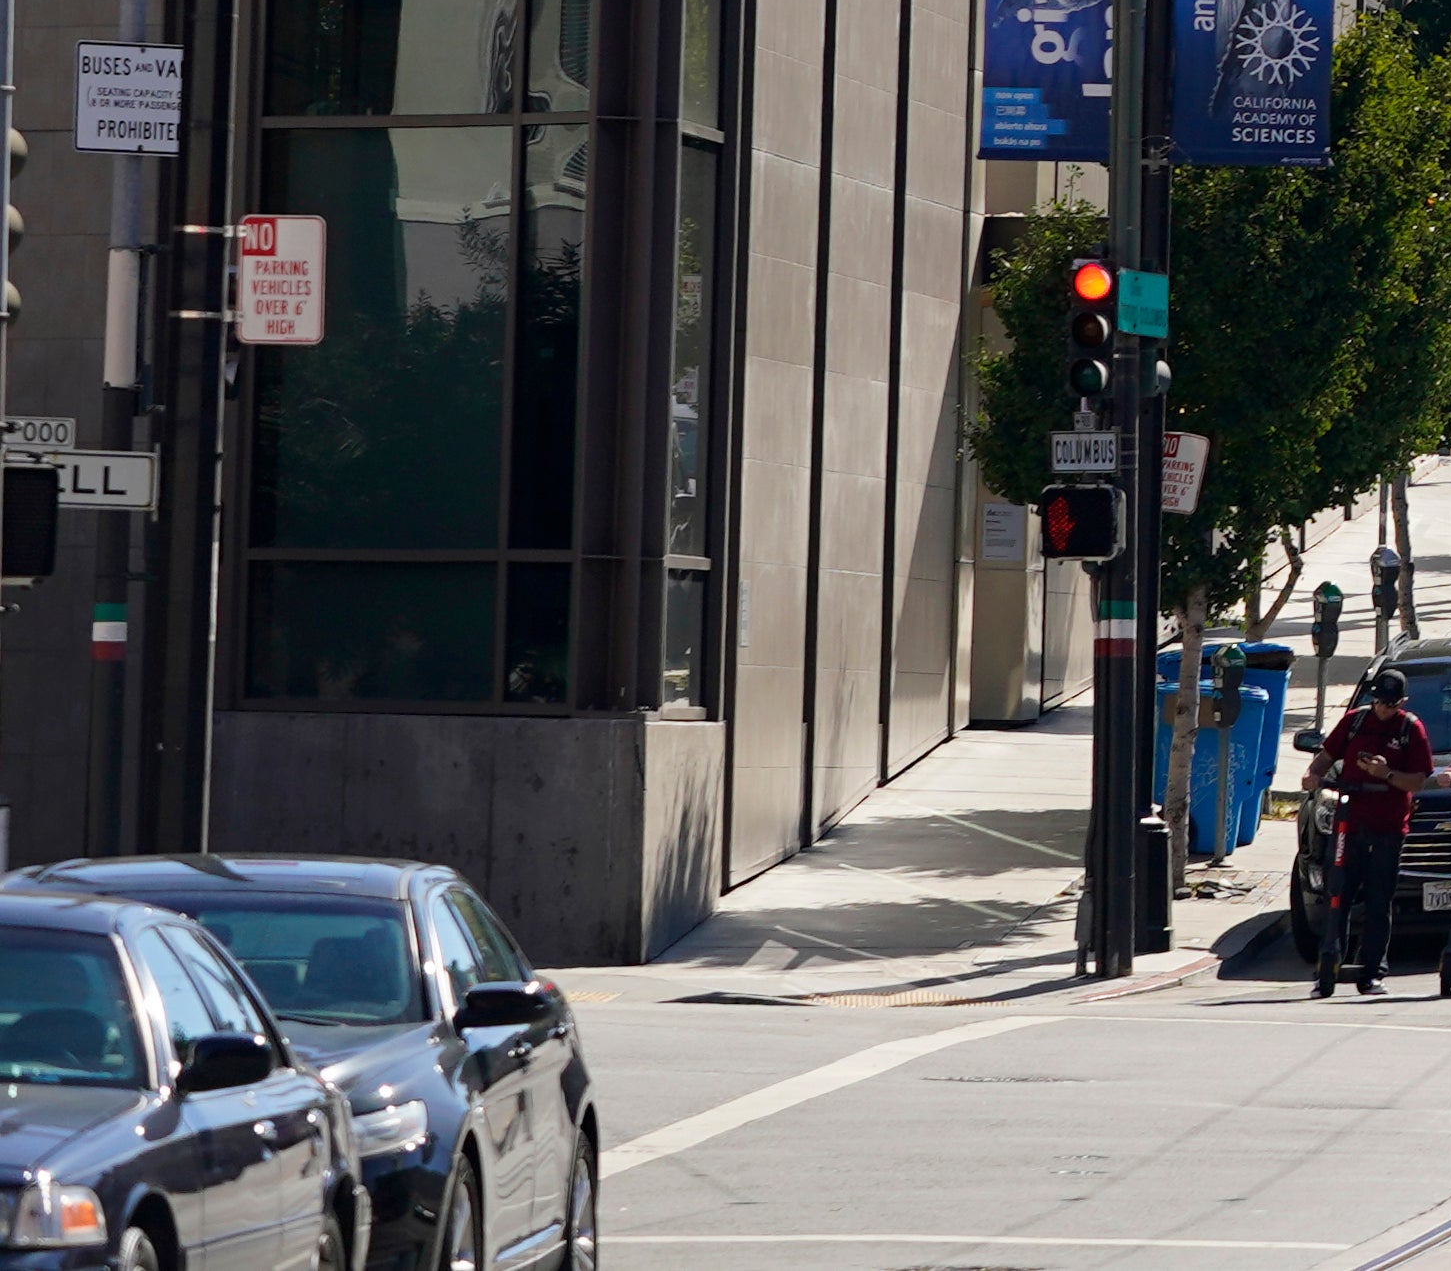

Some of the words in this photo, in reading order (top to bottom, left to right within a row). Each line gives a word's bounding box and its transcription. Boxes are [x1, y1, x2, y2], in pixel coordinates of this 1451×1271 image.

[82, 56, 132, 76] BUSES
[135, 63, 153, 73] AND
[97, 87, 131, 97] SEATING
[133, 89, 173, 99] CAPACITY
[114, 100, 136, 109] MORE
[139, 101, 182, 111] PASSENGE
[1233, 95, 1317, 110] CALIFORNIA
[1232, 111, 1296, 126] ACADEMY
[1299, 114, 1317, 126] OF
[97, 119, 180, 141] PROHIBITE
[1231, 127, 1316, 144] SCIENCES
[244, 223, 275, 252] NO
[255, 260, 310, 276] PARKING
[252, 280, 312, 296] VEHICLES
[255, 299, 288, 315] OVER
[266, 319, 295, 335] HIGH
[1055, 440, 1114, 464] COLUMBUS
